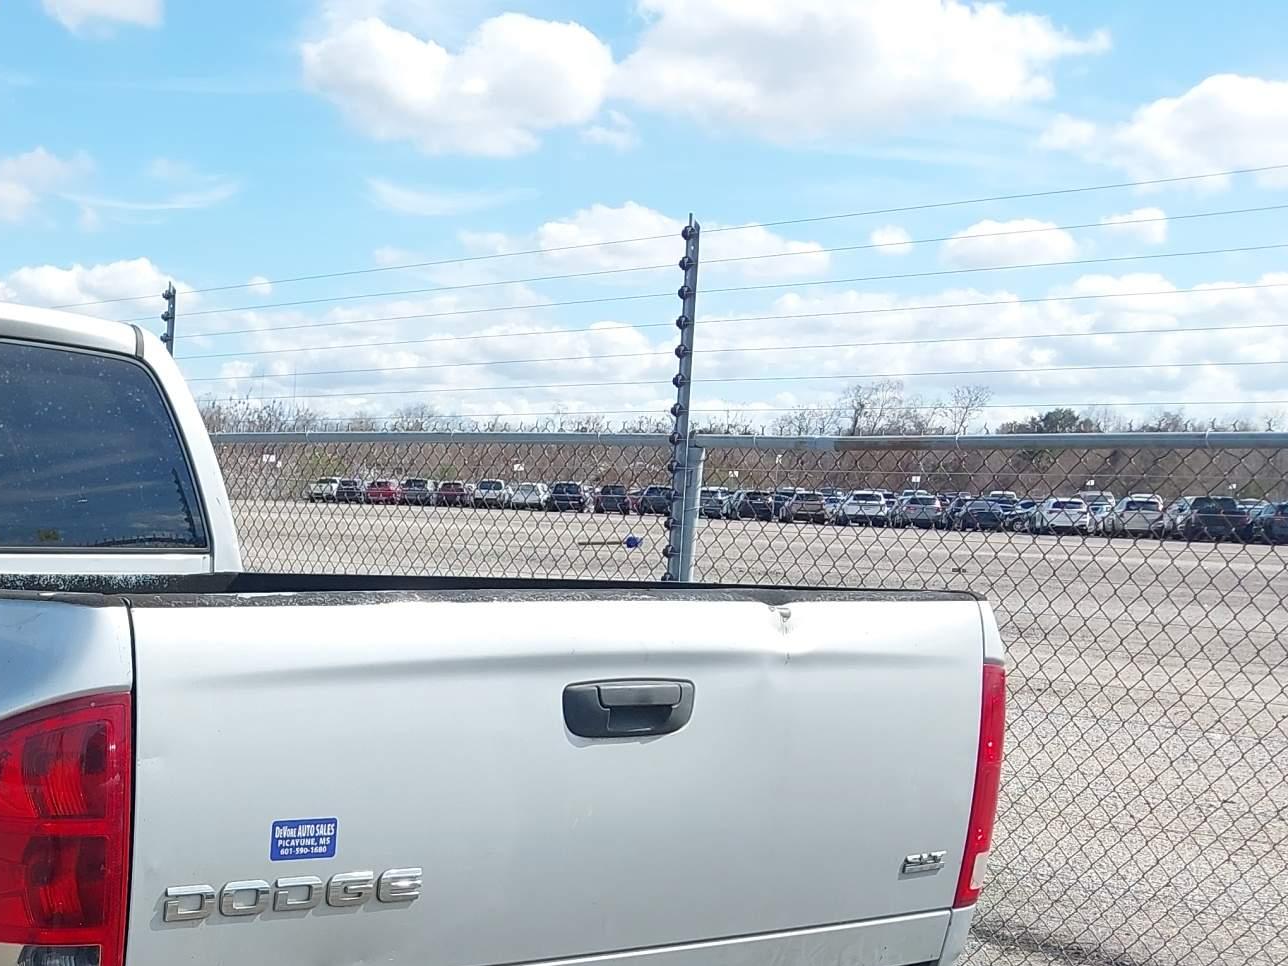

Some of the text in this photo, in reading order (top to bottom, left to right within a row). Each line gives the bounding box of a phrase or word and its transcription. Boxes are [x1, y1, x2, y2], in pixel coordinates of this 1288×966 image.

[297, 824, 315, 838] AUTO
[315, 823, 335, 837] SALES
[319, 836, 331, 846] MS
[163, 867, 423, 922] DODGE
